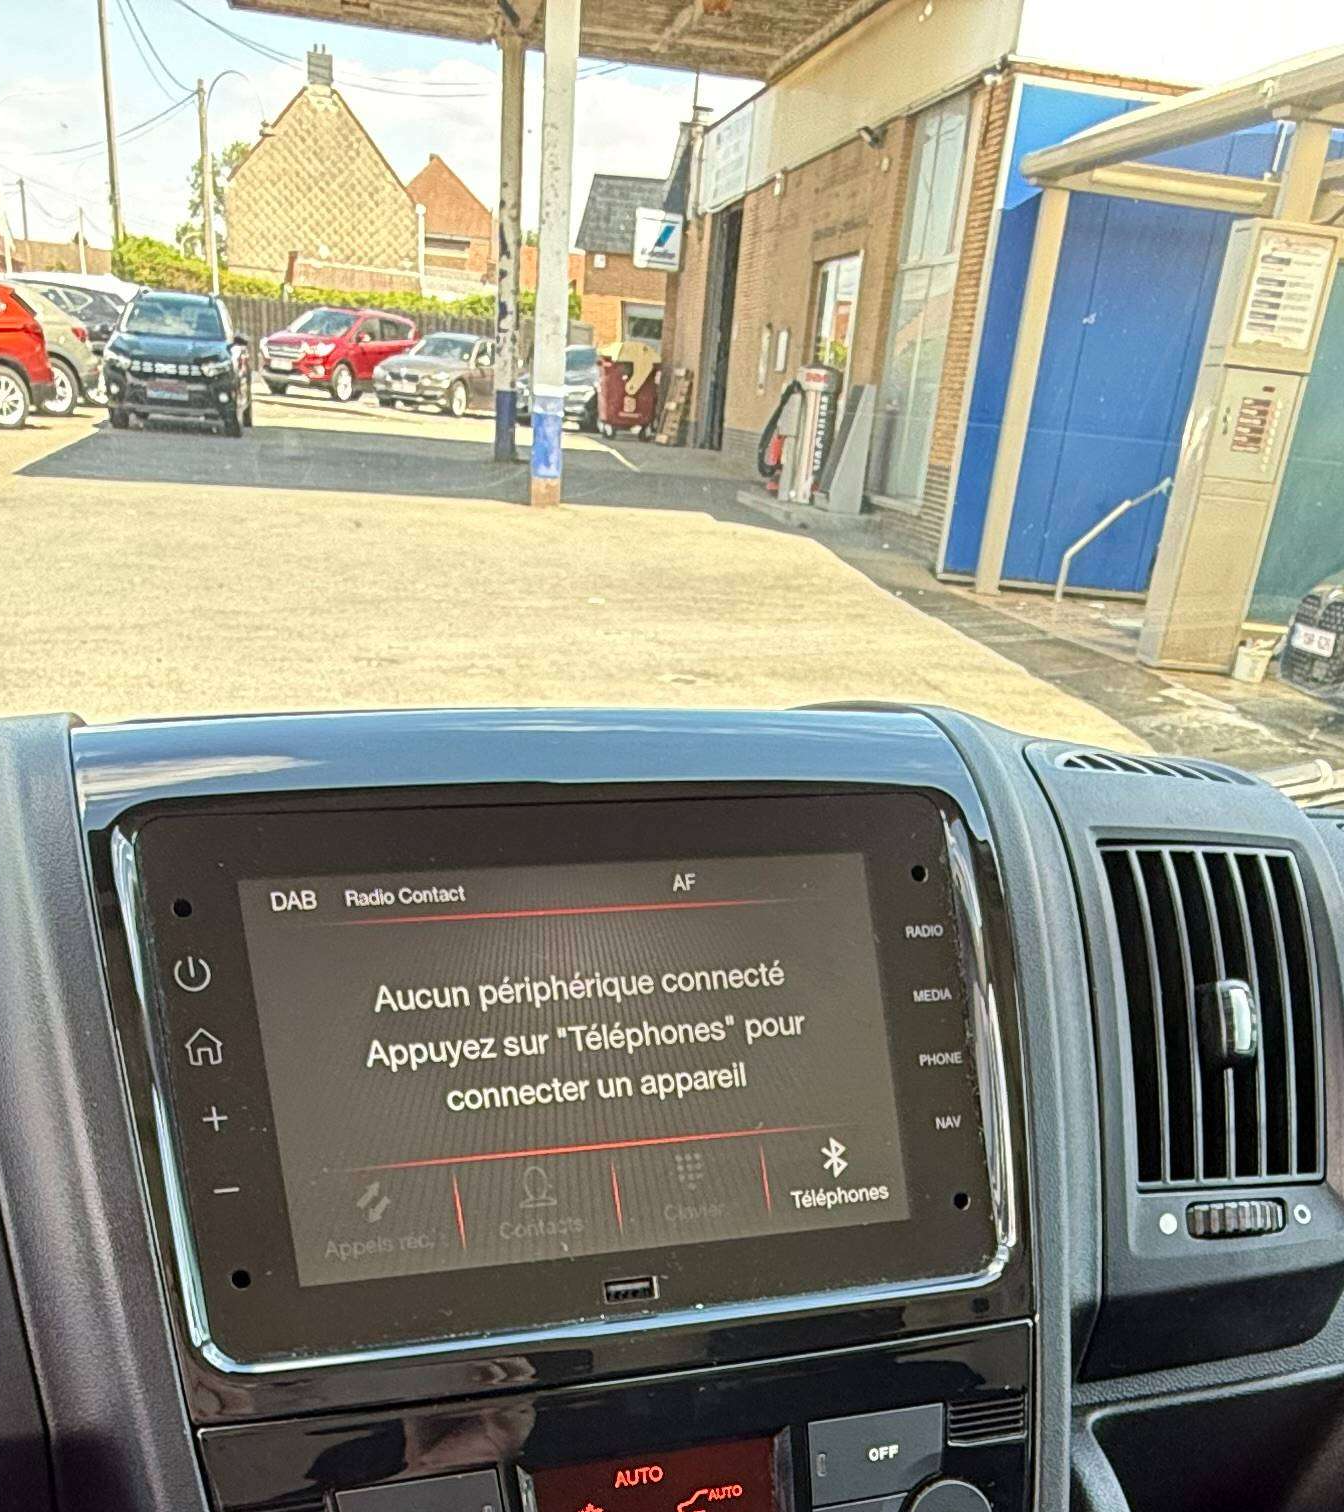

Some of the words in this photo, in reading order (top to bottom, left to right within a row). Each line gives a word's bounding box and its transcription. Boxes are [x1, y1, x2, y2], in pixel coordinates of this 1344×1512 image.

[672, 873, 697, 893] AF
[270, 889, 318, 912] DAB
[344, 887, 396, 908] Radio
[398, 885, 467, 906] Contact
[905, 924, 944, 939] RADIO
[374, 984, 471, 1014] Aucun
[479, 974, 655, 1012] périphérique
[661, 959, 786, 994] connecté
[913, 987, 952, 1003] MEDIA
[366, 1037, 498, 1073] Appuyez
[503, 1030, 550, 1058] sur
[557, 1014, 736, 1055] "Téléphones"
[744, 1012, 806, 1045] pour
[919, 1051, 963, 1067] PHONE
[446, 1075, 591, 1112] connecter
[597, 1072, 634, 1099] un
[640, 1061, 748, 1101] appareil
[935, 1115, 962, 1130] NAV
[789, 1182, 890, 1210] Téléphones
[499, 1217, 585, 1239] Contacts
[324, 1237, 394, 1261] Appels
[868, 1444, 899, 1462] OFF
[614, 1465, 664, 1489] AUTO
[707, 1484, 743, 1502] AUTO
